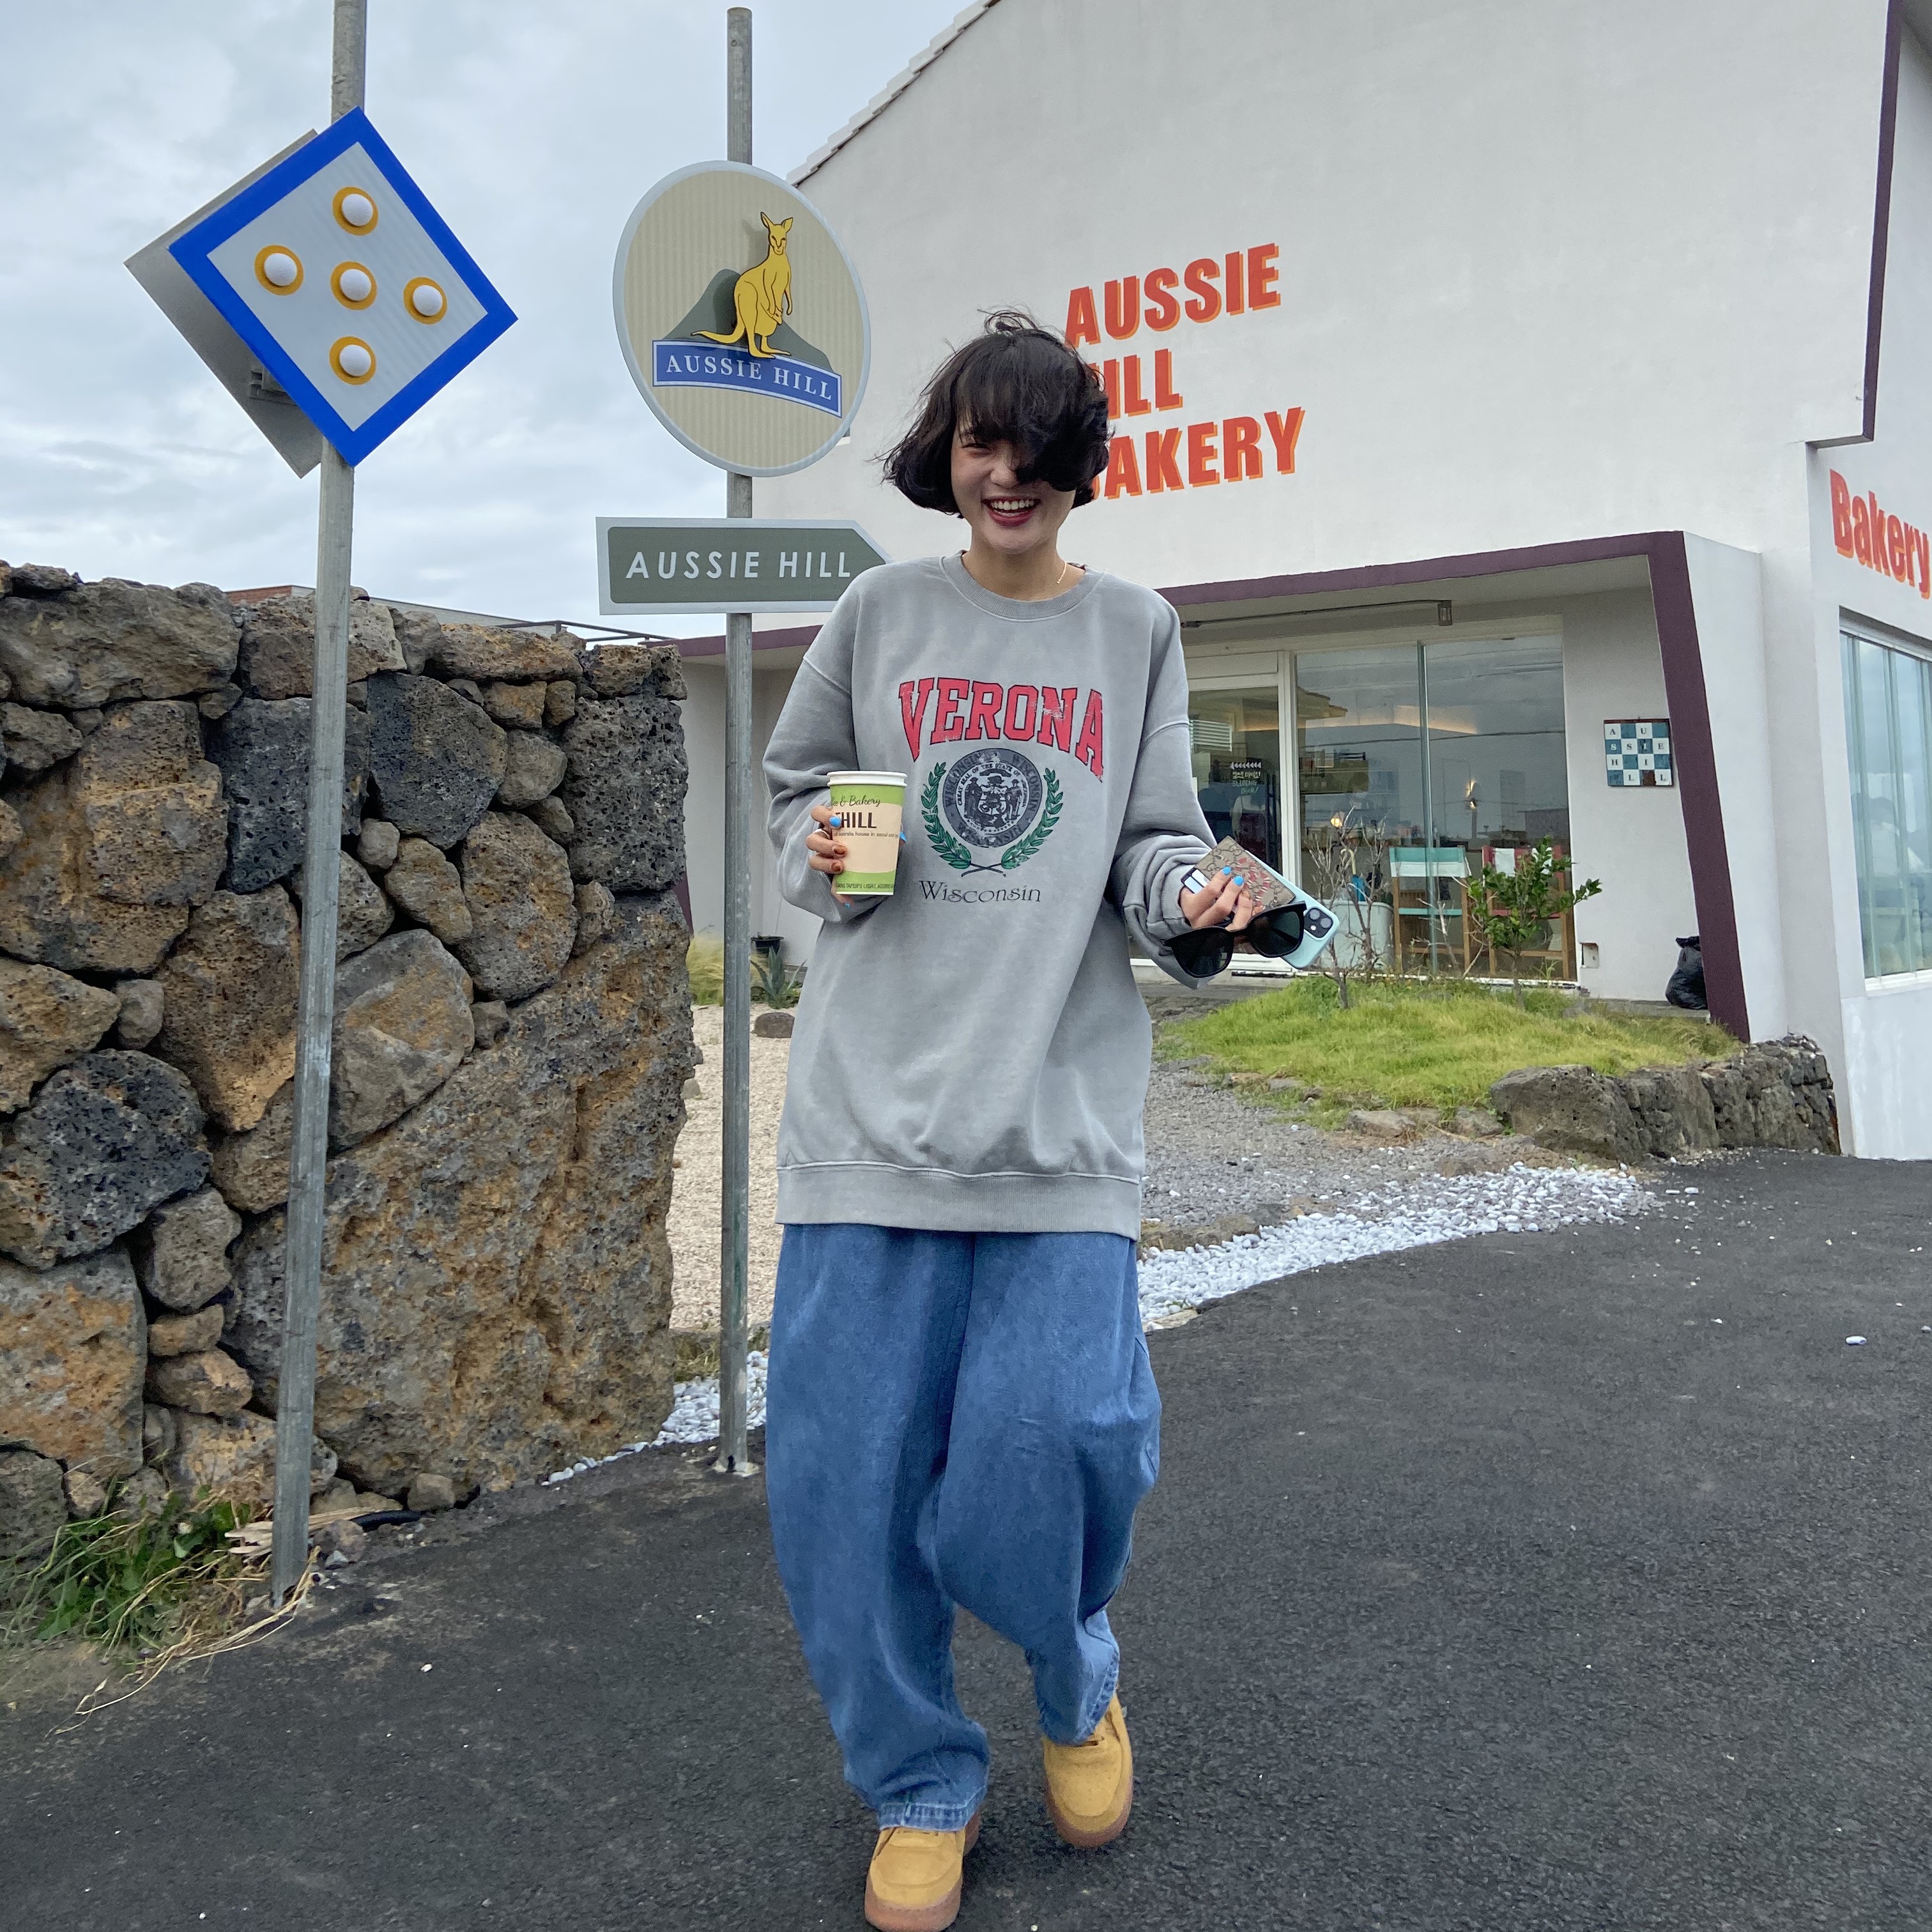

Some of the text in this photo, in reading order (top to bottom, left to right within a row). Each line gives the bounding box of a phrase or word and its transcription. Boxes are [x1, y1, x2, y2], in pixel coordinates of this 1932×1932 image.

[1065, 243, 1281, 348] AUSSIE
[666, 355, 833, 401] AUSSIE HILL
[1087, 349, 1183, 420] ILL
[1090, 406, 1305, 500] AKERY
[1830, 468, 1930, 599] Bakery
[625, 551, 851, 579] AUSSIE HILL
[898, 677, 1104, 783] VERONA
[840, 795, 847, 807] &
[849, 795, 880, 807] Bakery
[841, 812, 877, 829] HILL
[919, 880, 1041, 903] Wisconsin
